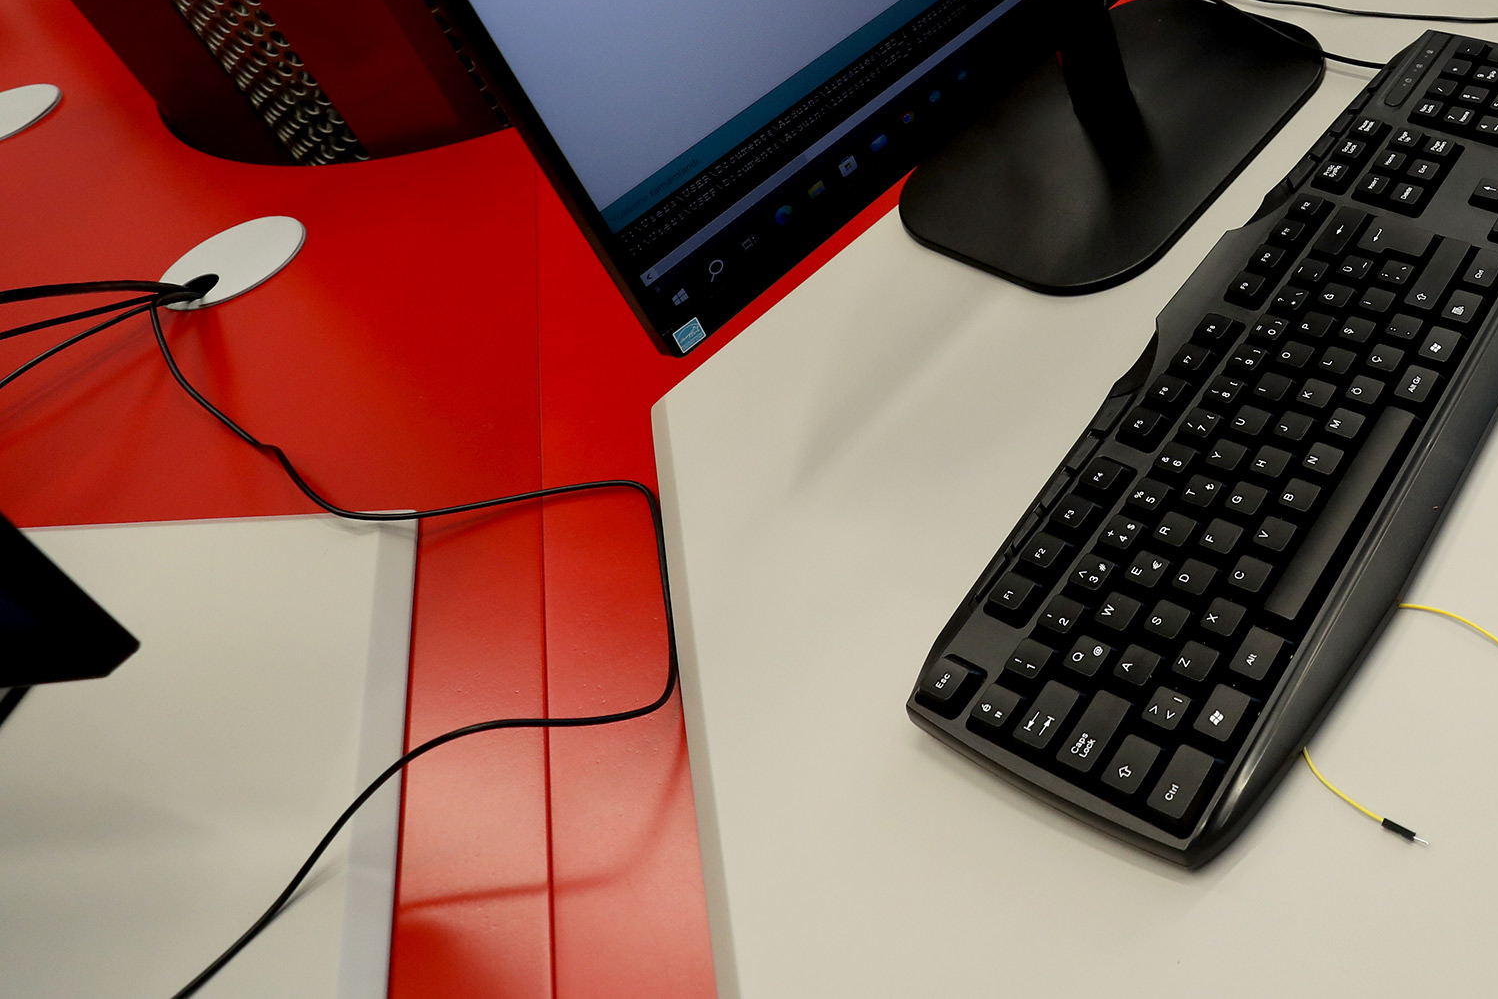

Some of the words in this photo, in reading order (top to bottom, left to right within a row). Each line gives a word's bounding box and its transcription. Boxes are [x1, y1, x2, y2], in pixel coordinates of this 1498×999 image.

[1384, 154, 1396, 165] Home
[1418, 165, 1428, 174] End
[1400, 187, 1413, 200] Delete
[1300, 201, 1311, 210] F12
[1281, 228, 1290, 236] F11
[1260, 252, 1271, 262] F10
[1474, 269, 1484, 279] Ctrl
[1240, 282, 1249, 290] F9
[1206, 325, 1216, 333] F8
[1183, 355, 1192, 364] F7
[1159, 387, 1169, 395] F6
[1302, 391, 1313, 399] K
[1351, 387, 1362, 395] Ö
[1133, 420, 1144, 428] F5
[1235, 418, 1246, 426] U
[1329, 419, 1341, 429] M
[1256, 459, 1267, 468] H
[1307, 456, 1318, 465] N
[1093, 472, 1103, 482] F4
[1145, 496, 1156, 504] 5
[1231, 495, 1243, 504] G
[1283, 493, 1294, 502] B
[1064, 509, 1075, 519] F3
[1159, 526, 1171, 535] R
[1258, 530, 1269, 538] V
[1205, 534, 1214, 543] F
[1034, 548, 1046, 559] F2
[1130, 566, 1143, 576] E
[1234, 571, 1245, 580] C
[1089, 575, 1099, 583] 3
[1178, 574, 1190, 583] D
[1003, 590, 1014, 600] F1
[1101, 604, 1115, 616] W
[1058, 617, 1069, 626] 2
[1151, 616, 1162, 625] S
[1206, 613, 1218, 623] X
[1093, 646, 1103, 656] @
[1072, 652, 1084, 662] Q
[1246, 654, 1257, 666] Alt
[1178, 657, 1191, 668] Z
[1122, 663, 1133, 672] A
[935, 673, 951, 689] Esc
[1071, 732, 1089, 754] Caps
[1078, 737, 1096, 758] Lock
[1165, 784, 1179, 801] Ctrl
